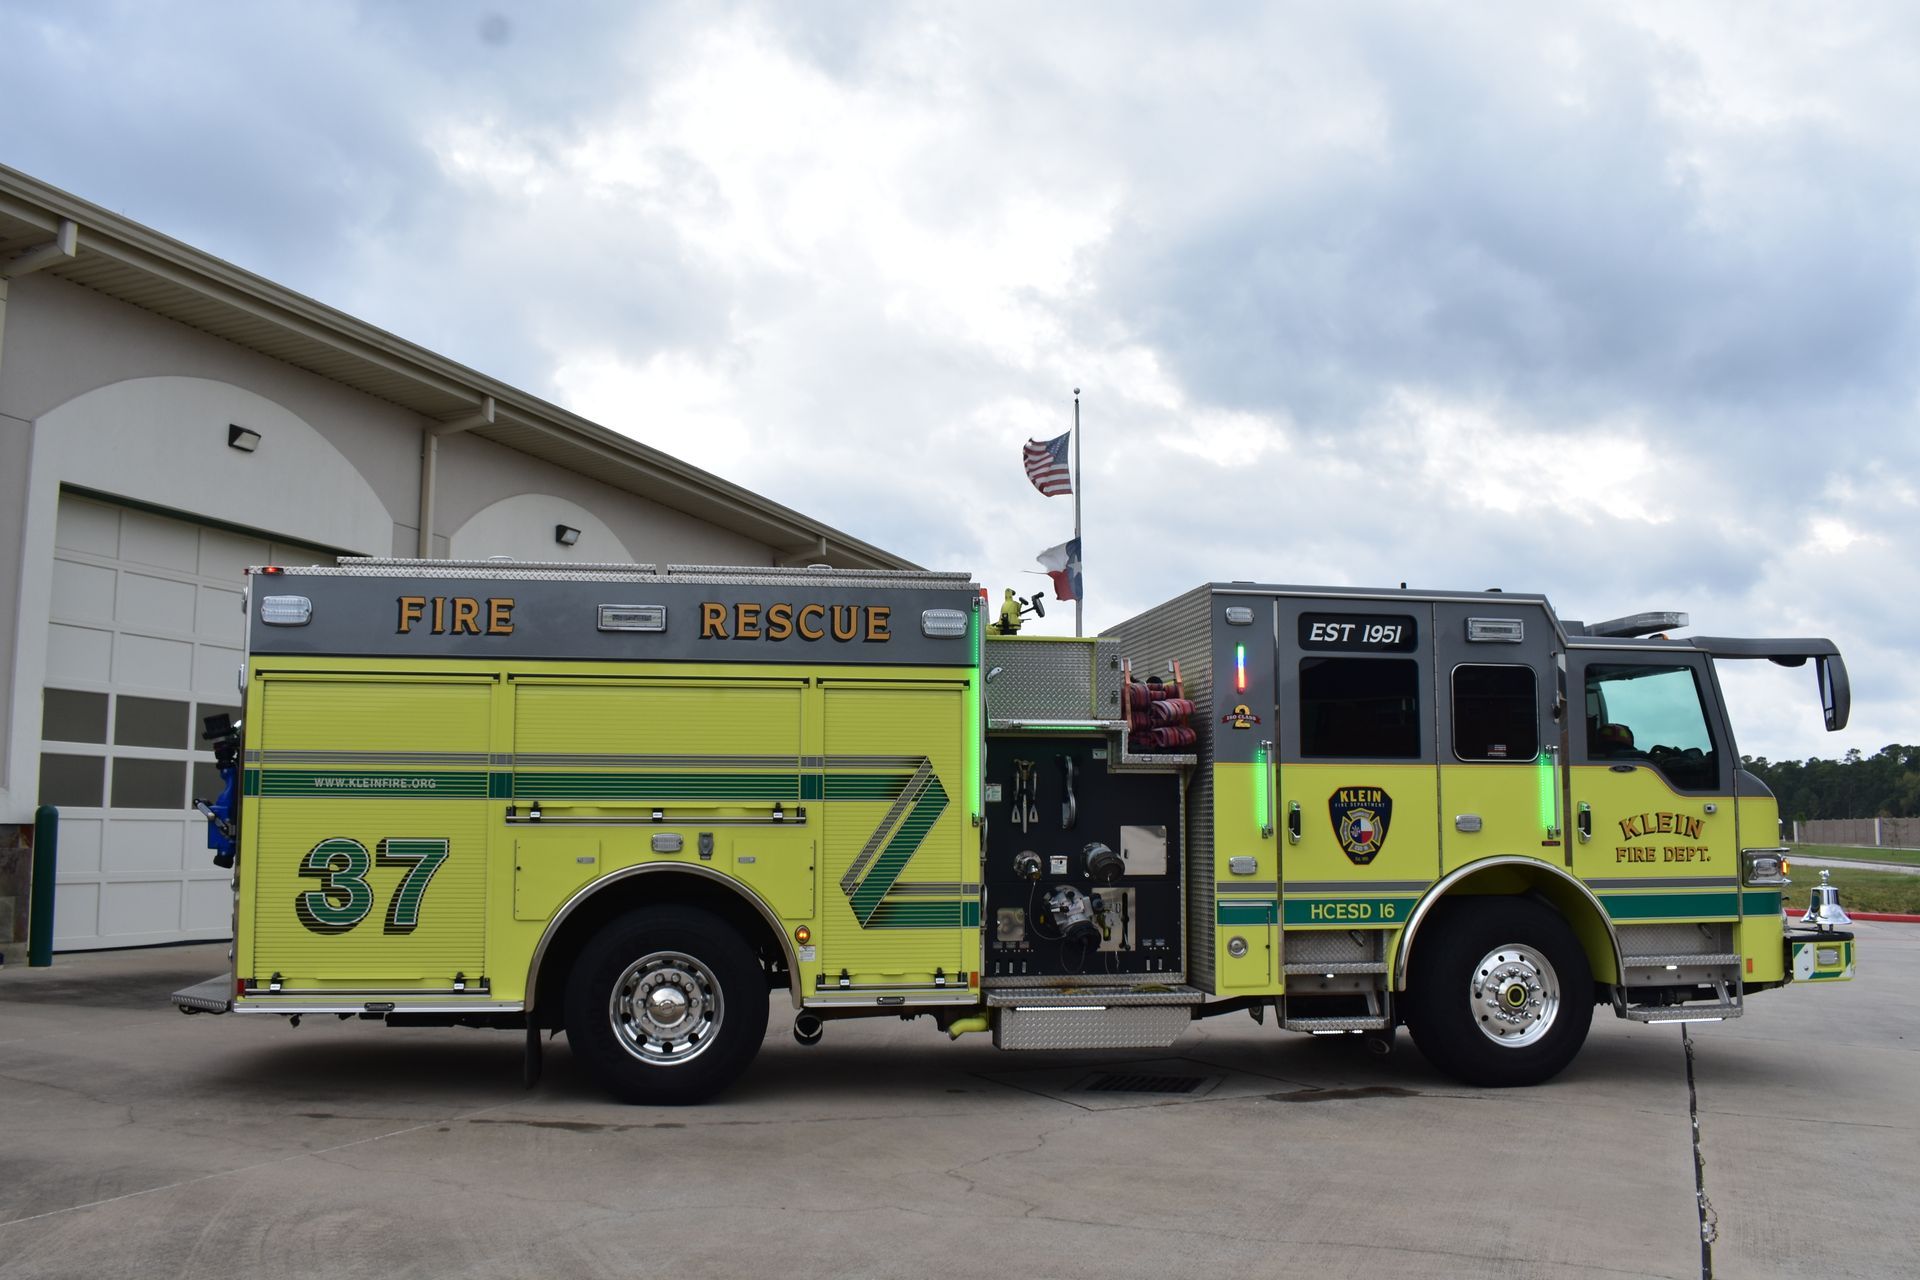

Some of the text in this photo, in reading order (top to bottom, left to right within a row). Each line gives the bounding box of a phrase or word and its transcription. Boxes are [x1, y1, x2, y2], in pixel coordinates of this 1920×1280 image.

[396, 596, 515, 635] FIRE
[699, 602, 891, 642] RESCUE
[1309, 623, 1401, 643] EST 1951
[1233, 704, 1251, 729] 2
[314, 777, 436, 789] WWW.KLEINFIRE.ORG
[1340, 790, 1380, 802] KLEIN
[1618, 812, 1705, 841] KLEIN
[1616, 847, 1711, 863] FIRE DEPT.
[295, 836, 449, 935] 37
[1311, 904, 1395, 919] HCESD 16
